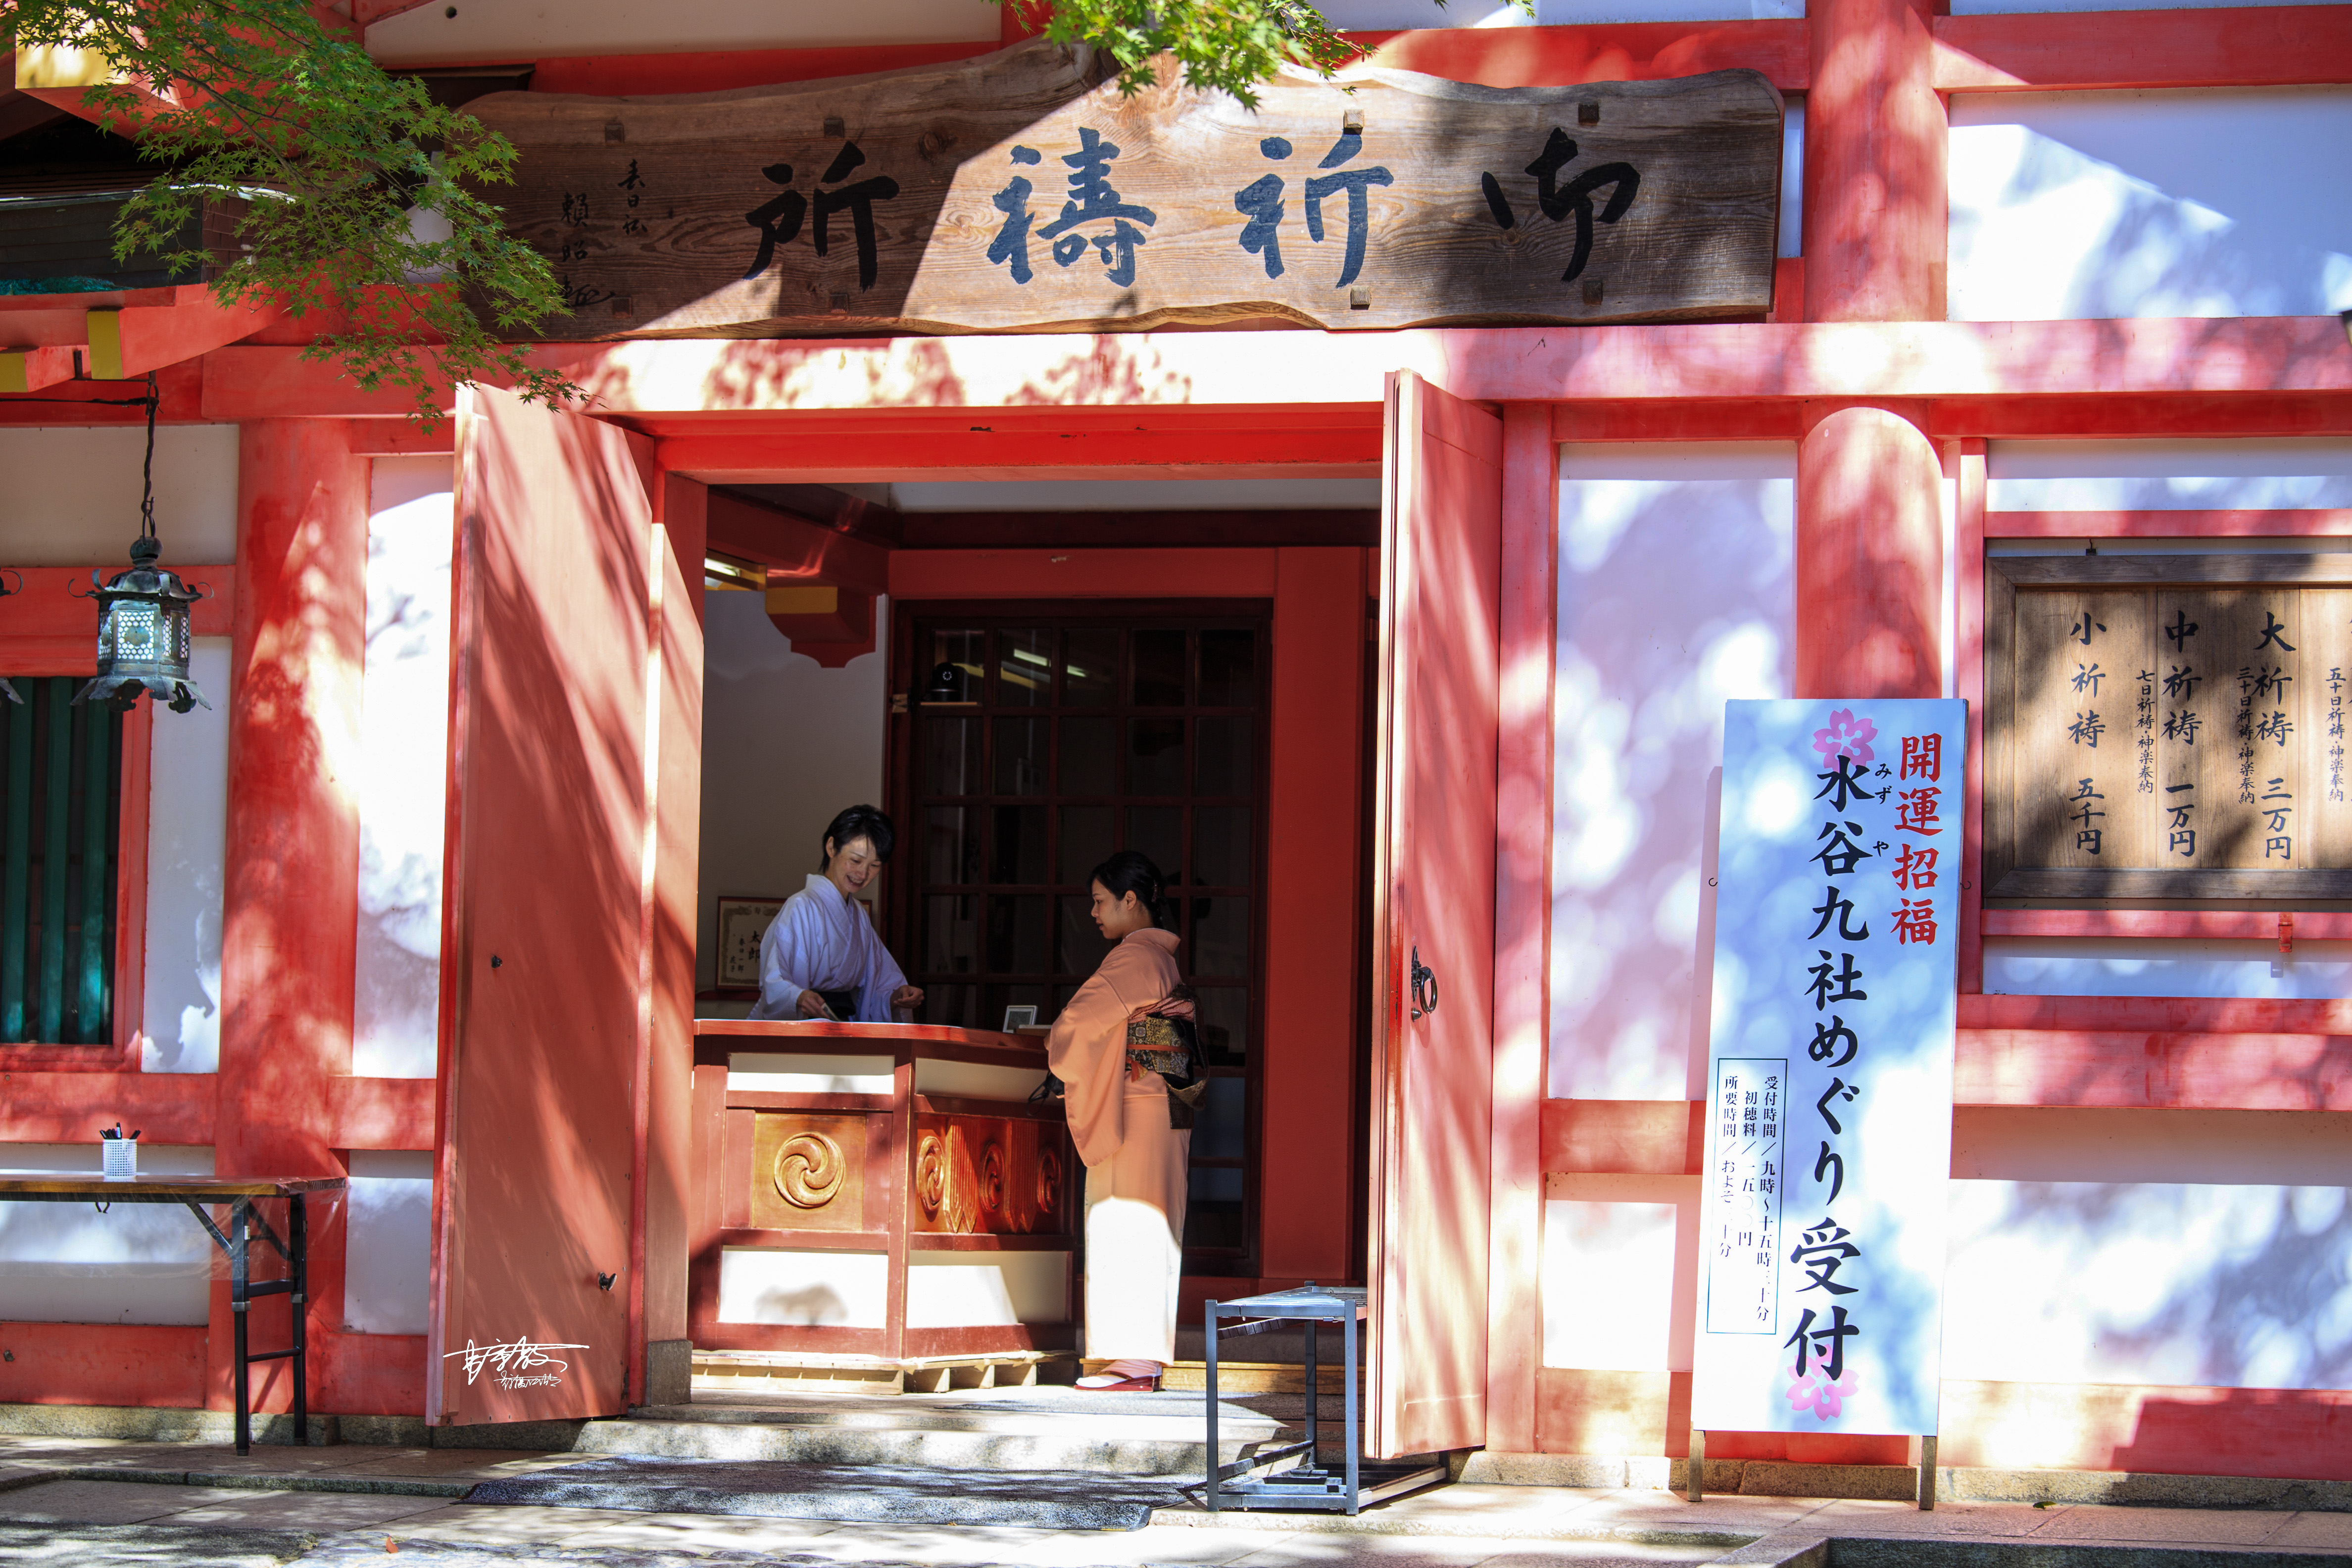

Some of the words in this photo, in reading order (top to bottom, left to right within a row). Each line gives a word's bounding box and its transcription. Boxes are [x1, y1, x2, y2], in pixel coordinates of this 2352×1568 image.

[2068, 612, 2107, 748] 小祈祷
[2160, 610, 2203, 746] 中祈祷
[2254, 611, 2297, 747] 大祈祷
[1890, 733, 1943, 945] 開運招福
[2068, 778, 2106, 855] 五千円
[2164, 783, 2197, 858] 一万円
[2260, 778, 2293, 860] 三万円
[1784, 754, 1875, 1380] 水谷九社めぐり受付
